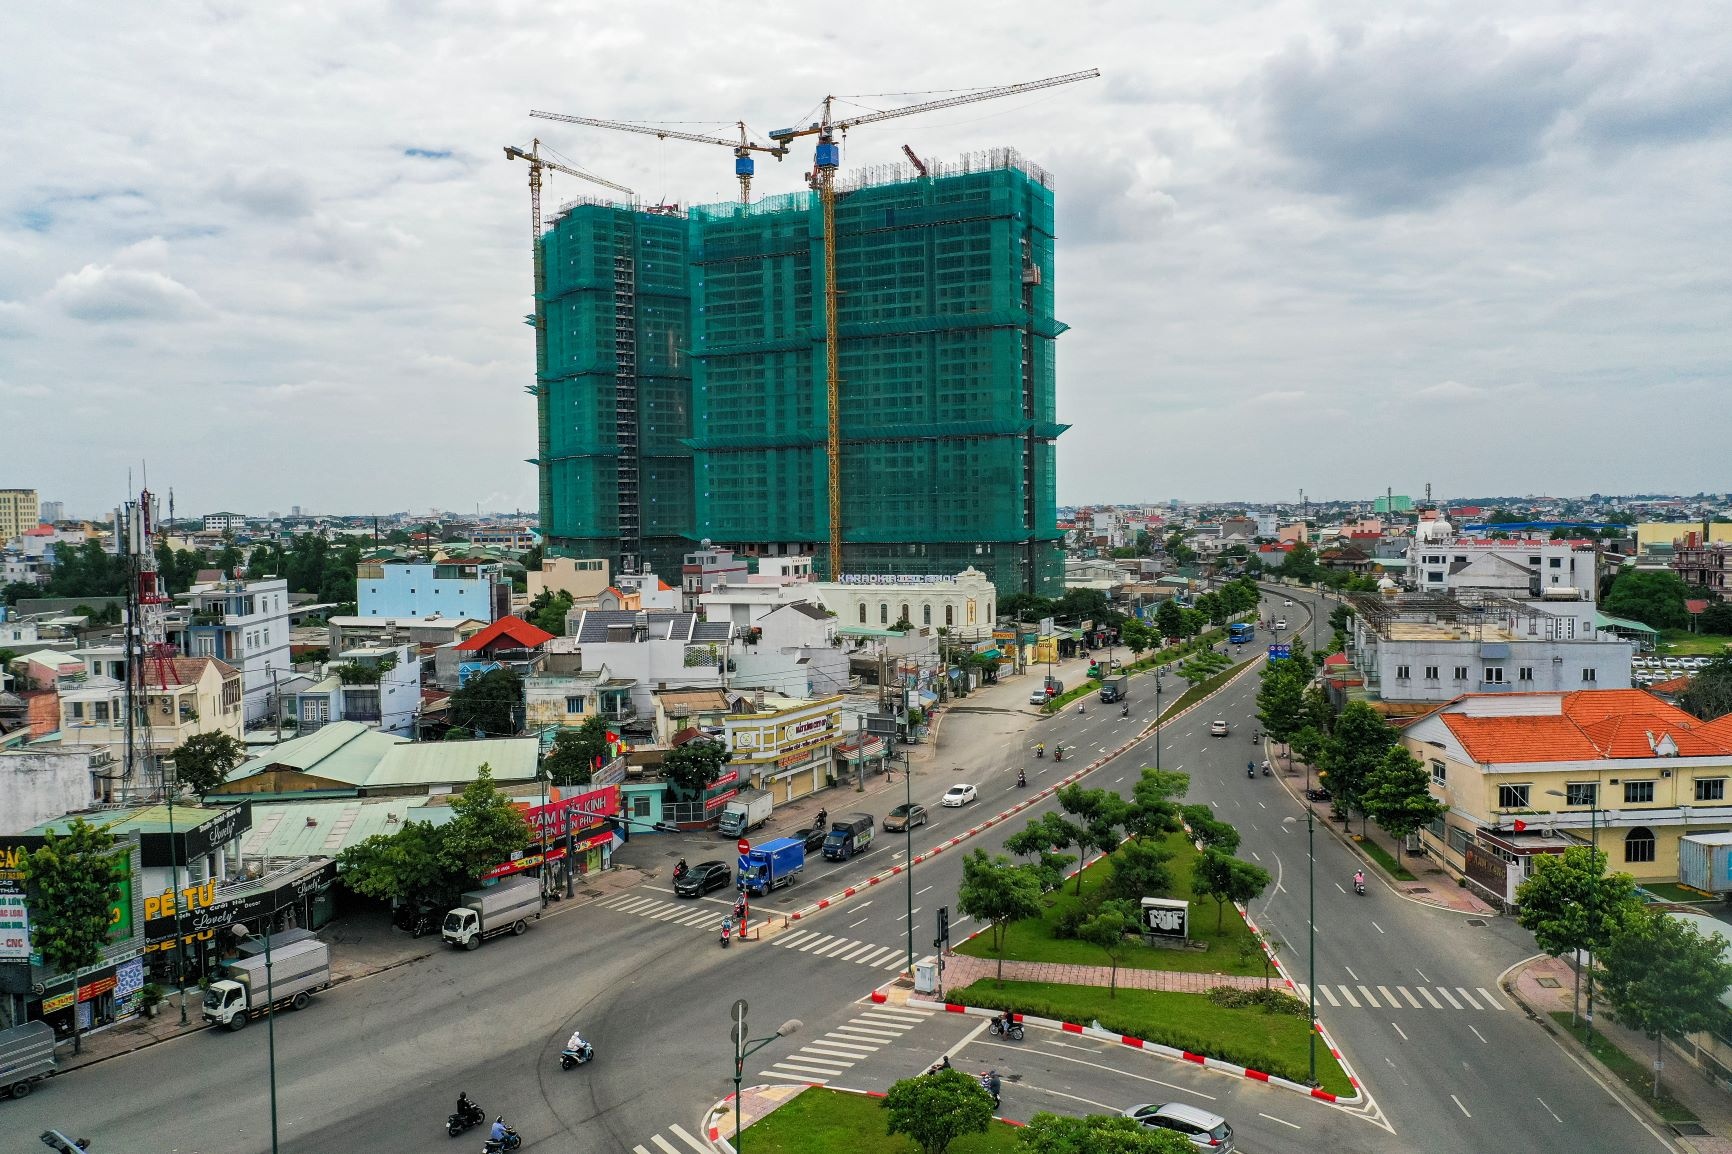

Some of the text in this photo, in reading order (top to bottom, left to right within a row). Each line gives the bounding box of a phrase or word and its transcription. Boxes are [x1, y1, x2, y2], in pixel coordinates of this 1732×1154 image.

[530, 812, 556, 828] TÂM
[584, 796, 606, 812] KÍNH
[182, 878, 216, 911] TƯ
[192, 910, 233, 930] Lovely
